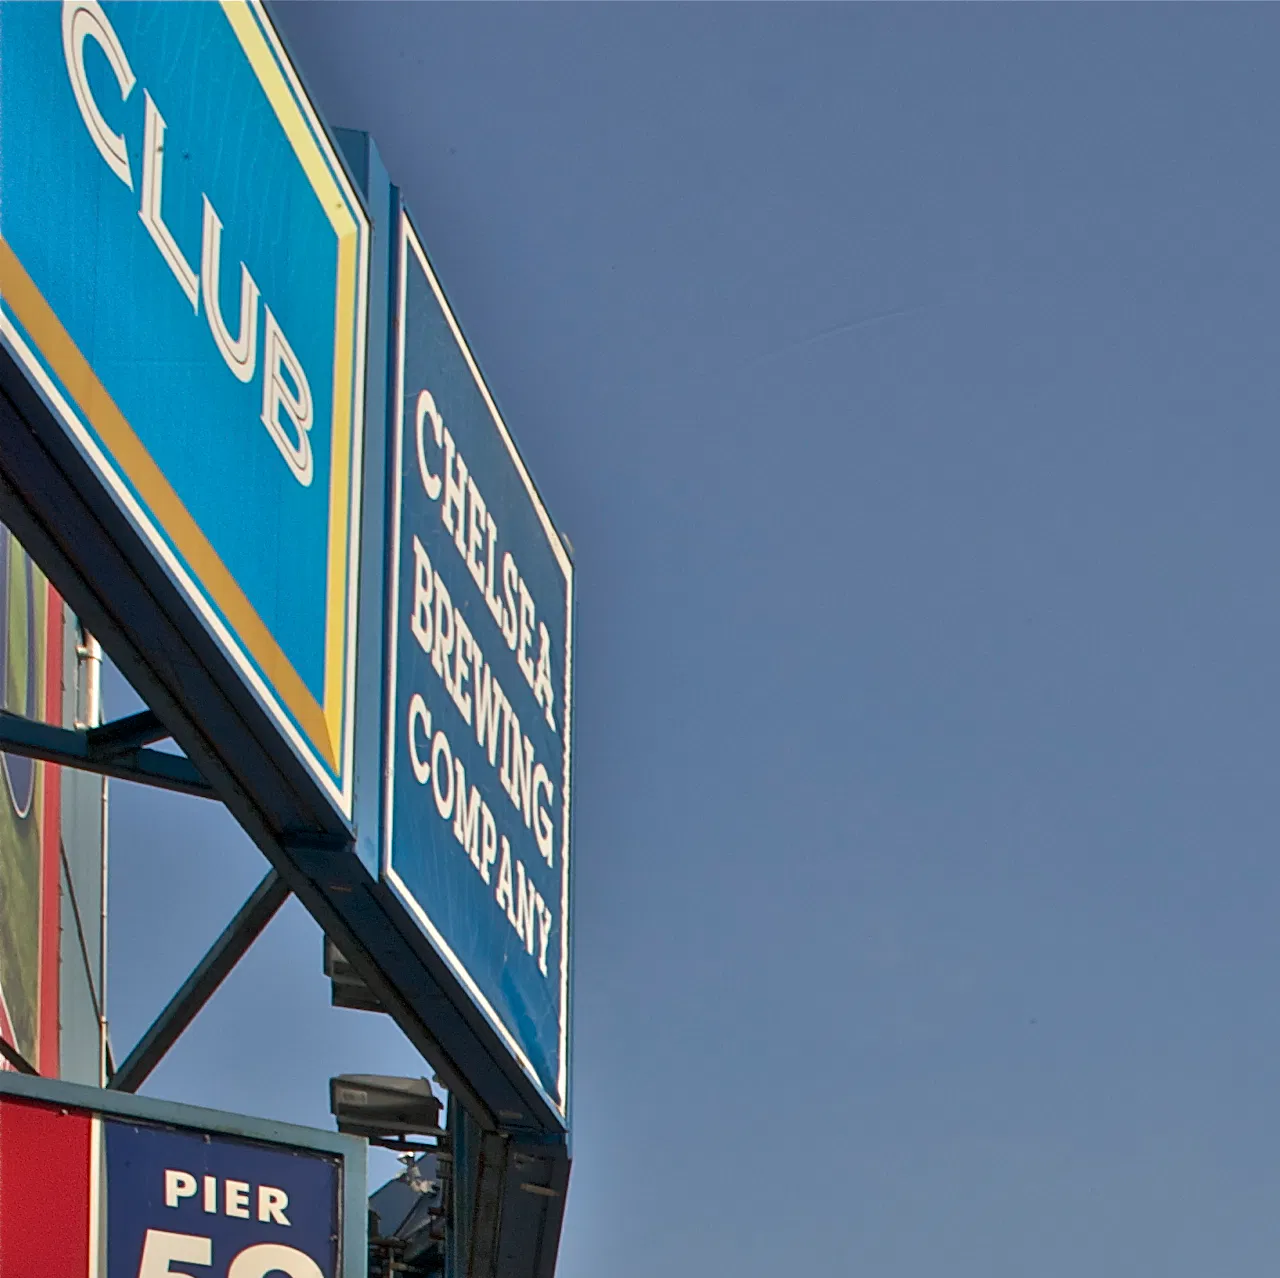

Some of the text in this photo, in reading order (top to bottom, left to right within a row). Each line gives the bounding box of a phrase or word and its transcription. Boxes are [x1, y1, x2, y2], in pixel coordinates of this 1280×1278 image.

[62, 0, 313, 487] CLUB
[411, 534, 553, 867] BREWING
[417, 389, 556, 731] CHELSEA
[407, 694, 553, 978] COMPANY
[164, 1168, 291, 1226] PIER
